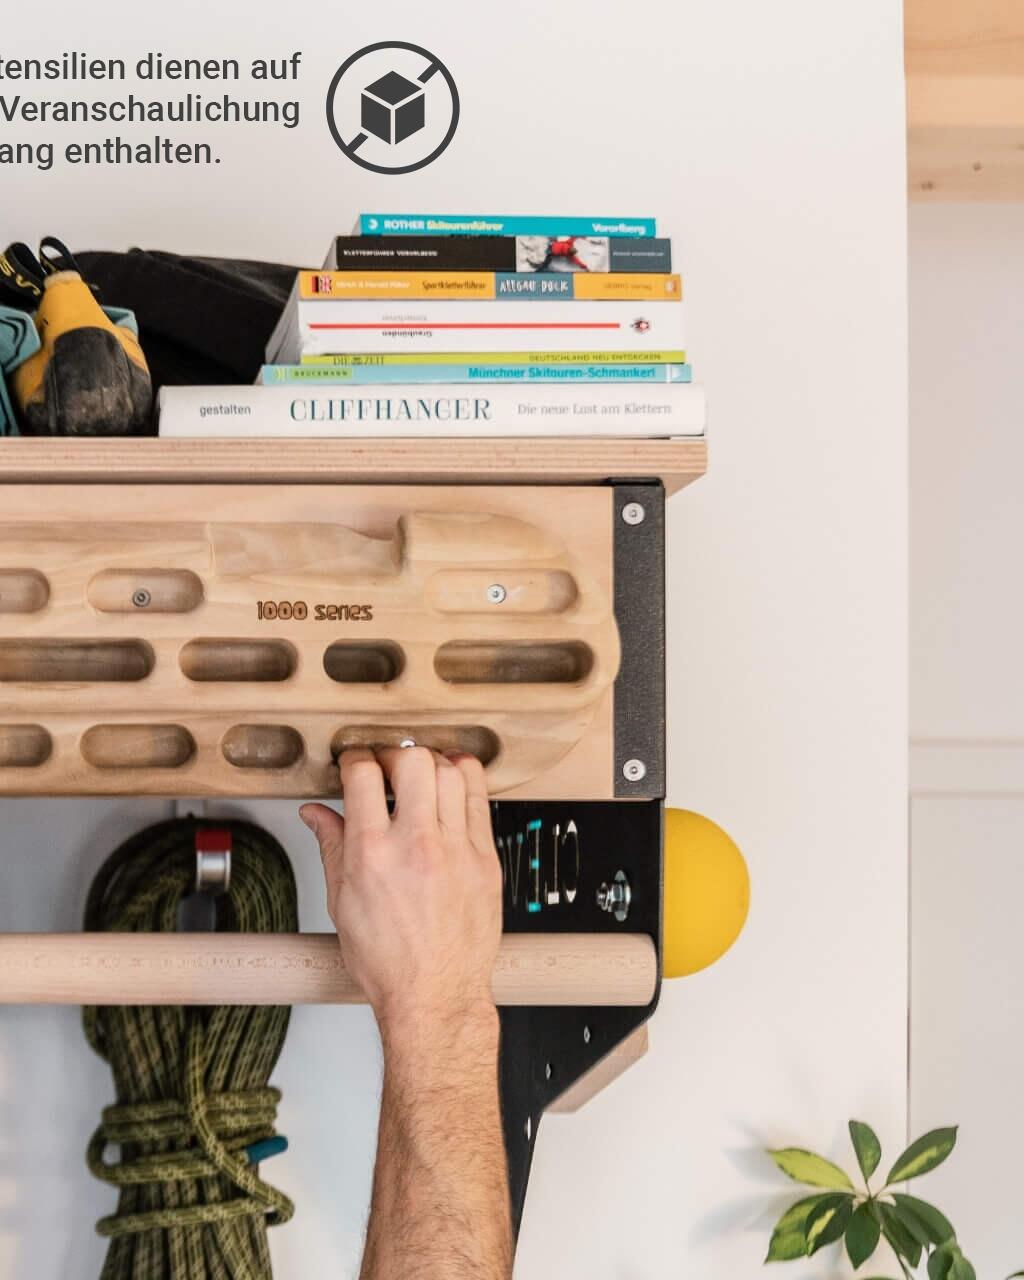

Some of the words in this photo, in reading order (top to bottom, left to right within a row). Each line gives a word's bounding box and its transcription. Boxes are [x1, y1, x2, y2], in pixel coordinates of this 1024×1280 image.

[383, 219, 425, 231] ROTHER
[528, 354, 589, 362] DEUTSCHLAND
[592, 354, 609, 362] NEU
[612, 353, 661, 361] ENTDECKEN
[468, 367, 525, 379] Münchner
[528, 367, 656, 379] Skitouren-Schmankerl
[199, 403, 251, 418] gestalten
[289, 398, 492, 422] CLIFFHANGER
[517, 403, 537, 415] Die
[540, 406, 569, 415] neue
[572, 403, 598, 415] Lust
[601, 406, 620, 415] am
[624, 403, 672, 415] Klettern
[256, 600, 308, 621] 1000
[314, 603, 373, 621] series
